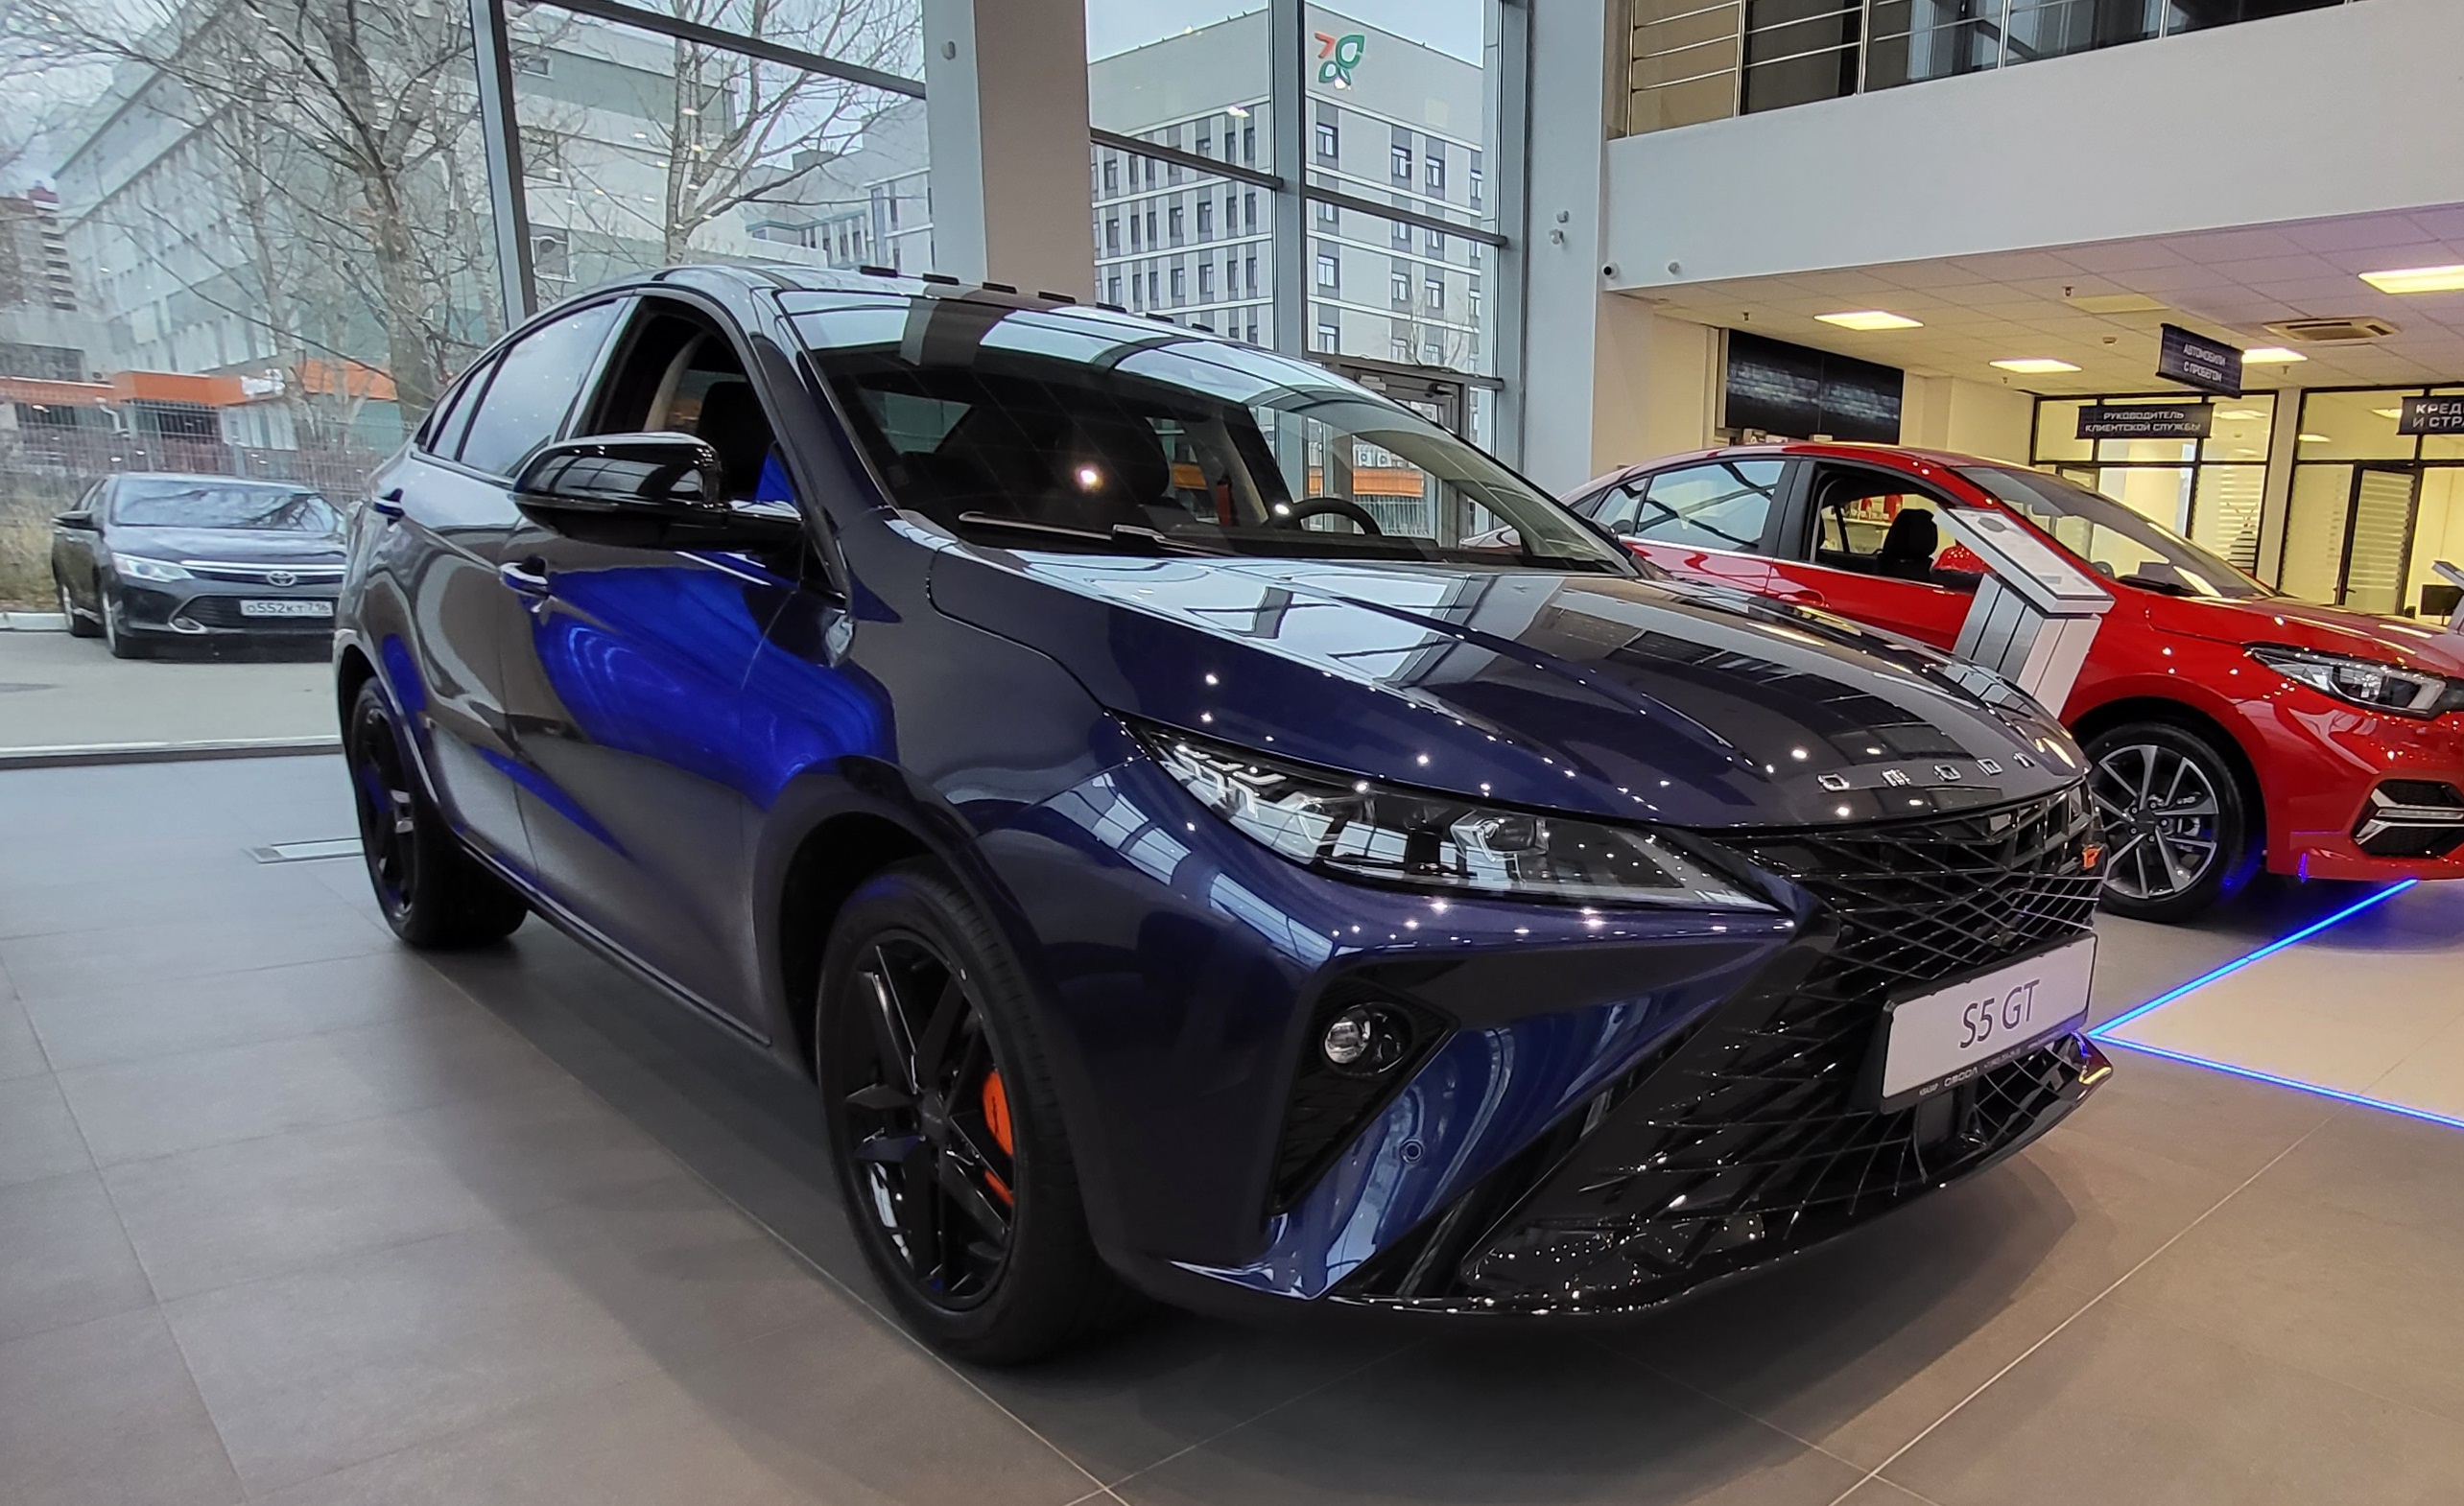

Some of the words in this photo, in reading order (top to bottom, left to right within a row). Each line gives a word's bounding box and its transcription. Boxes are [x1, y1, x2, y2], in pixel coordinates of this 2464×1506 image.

[2190, 363, 2223, 383] ПРОБЕГОМ
[2415, 403, 2464, 415] КРЕД
[2103, 411, 2185, 420] РУКОВОДИТЕЛЬ
[2085, 422, 2150, 433] КЛИЕНТСКОЙ
[2152, 422, 2201, 432] СЛУЖБЫ
[2412, 416, 2425, 428] И
[1959, 997, 1996, 1049] S5
[2002, 978, 2041, 1030] GT
